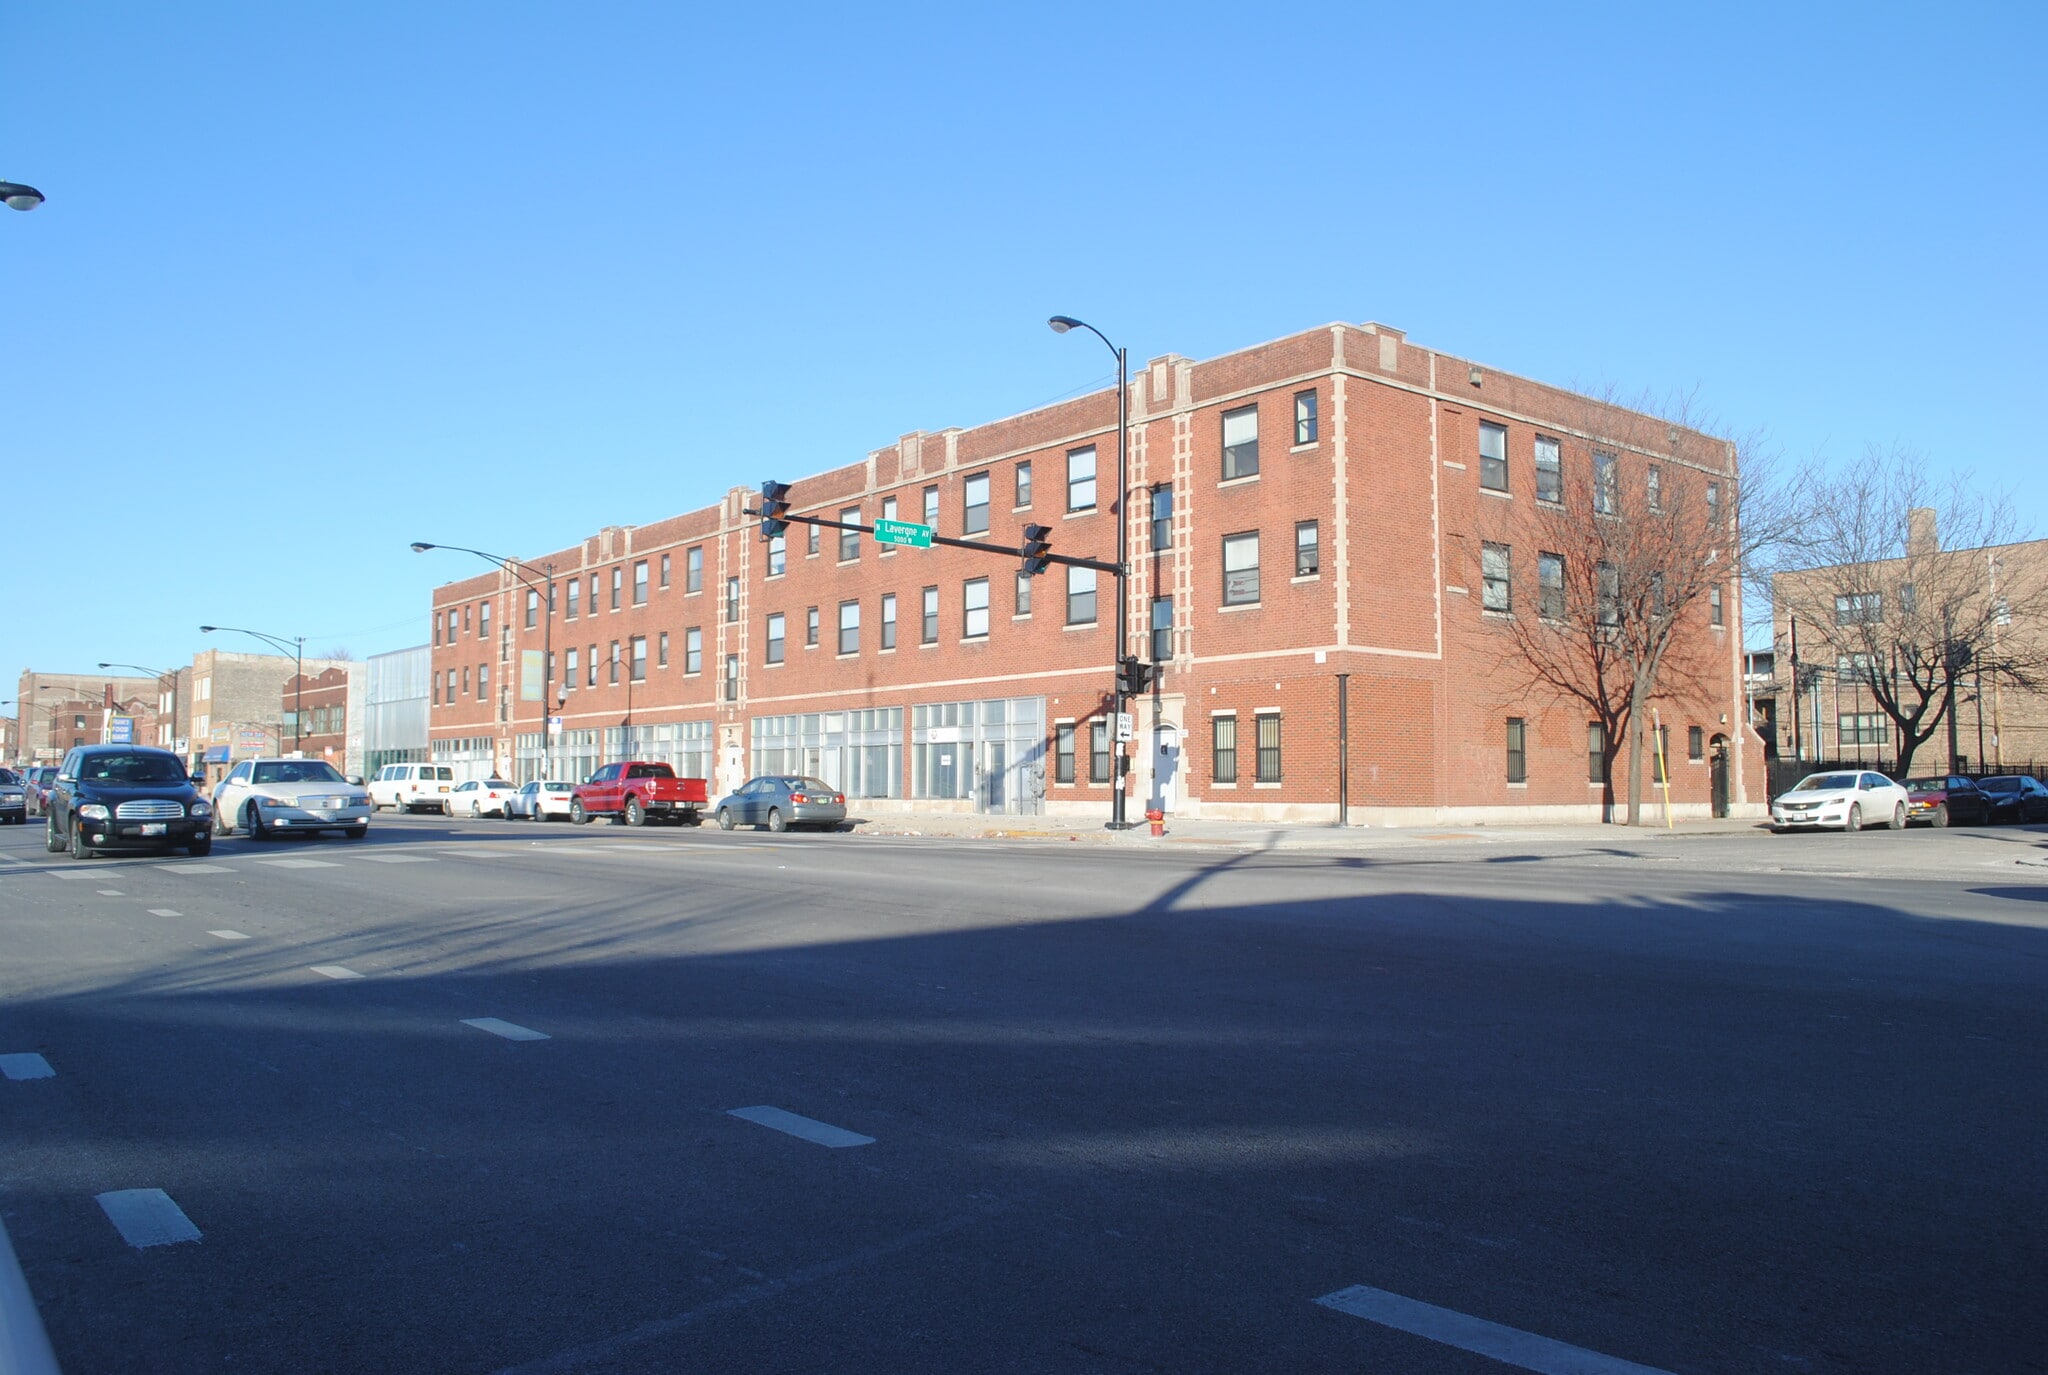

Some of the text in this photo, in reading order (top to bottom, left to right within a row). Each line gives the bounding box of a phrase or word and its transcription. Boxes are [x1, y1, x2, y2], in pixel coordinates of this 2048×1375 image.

[885, 522, 917, 537] Lavergne
[921, 529, 930, 538] AV
[894, 535, 907, 544] 5000
[1119, 715, 1131, 723] ONE
[1119, 723, 1131, 732] WAY
